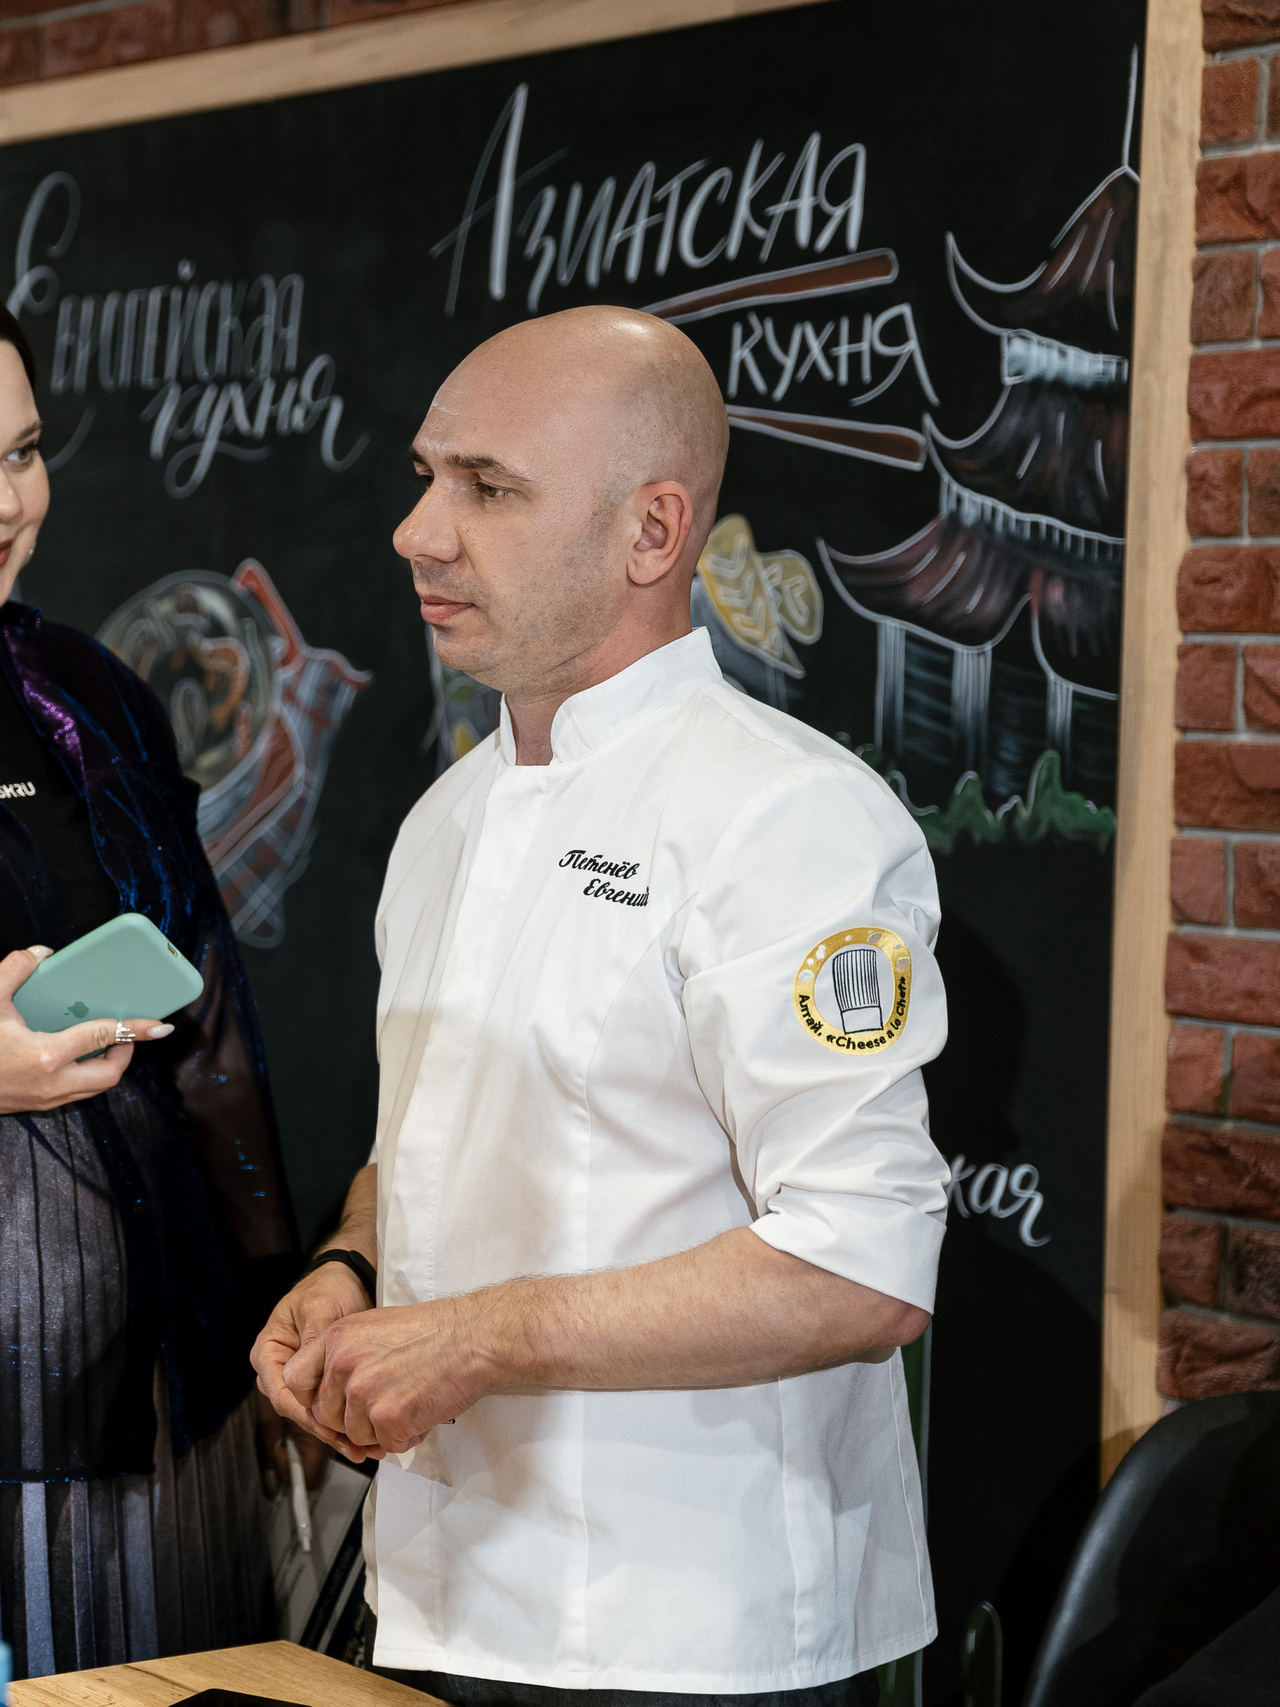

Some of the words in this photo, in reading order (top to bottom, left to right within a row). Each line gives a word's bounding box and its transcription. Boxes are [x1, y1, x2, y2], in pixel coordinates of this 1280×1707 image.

[558, 849, 640, 879] Петенёв
[886, 1029, 895, 1039] a
[890, 1018, 902, 1031] le
[946, 1154, 1052, 1248] кая
